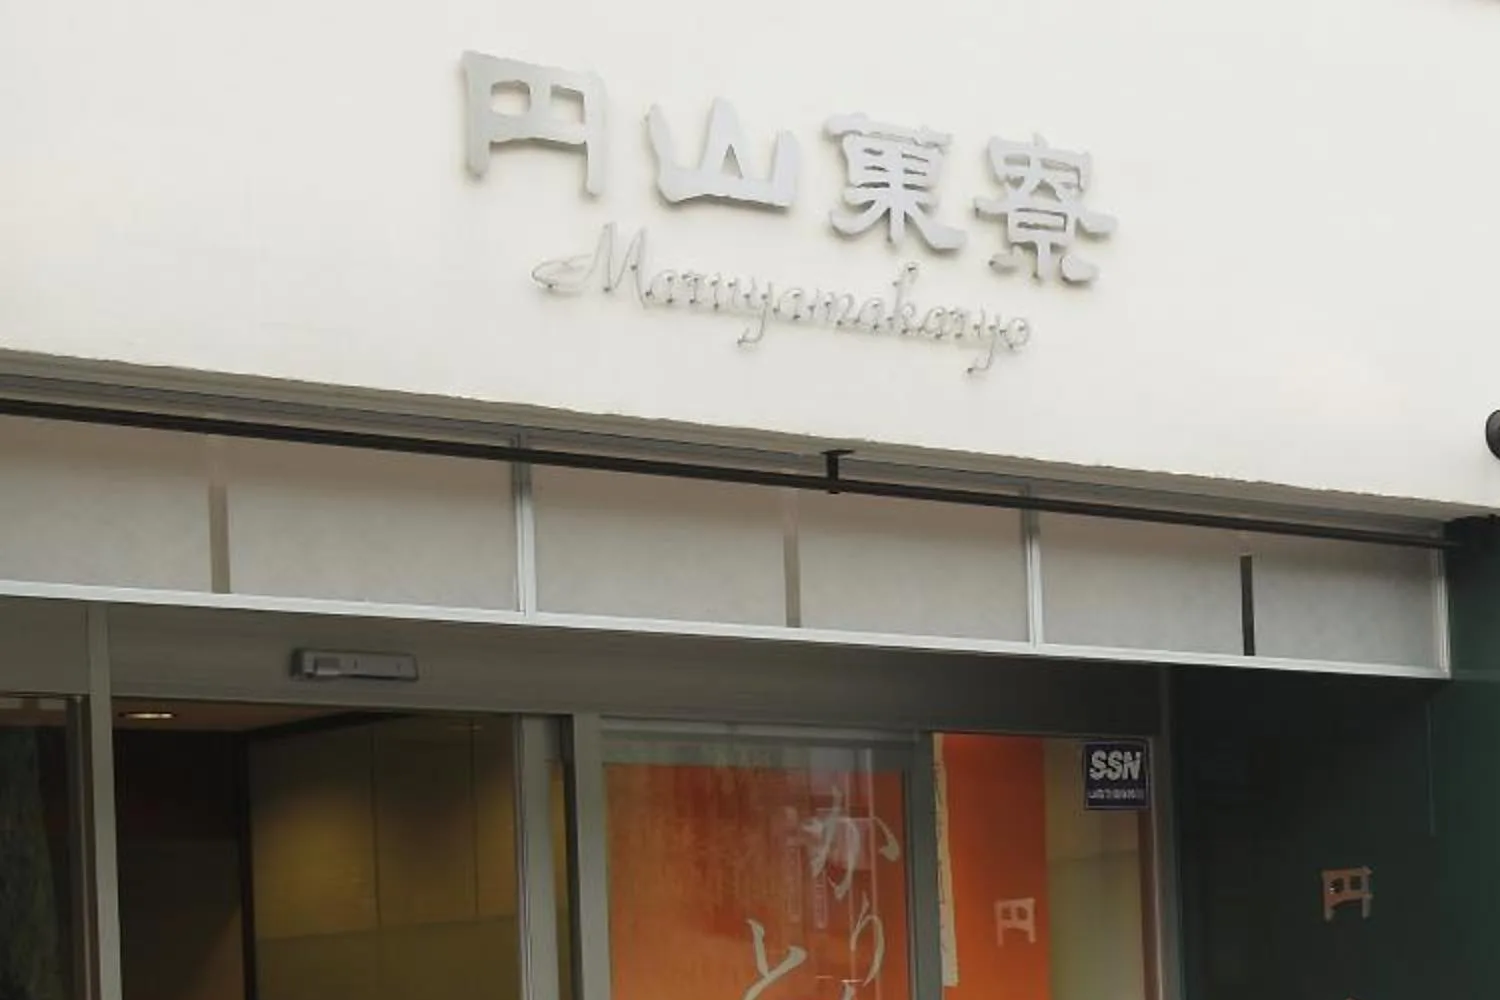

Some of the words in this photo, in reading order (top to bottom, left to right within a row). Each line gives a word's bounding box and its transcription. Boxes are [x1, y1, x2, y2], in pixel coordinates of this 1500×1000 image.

[461, 50, 1116, 286] 円山菓寮
[1089, 750, 1141, 780] SSN
